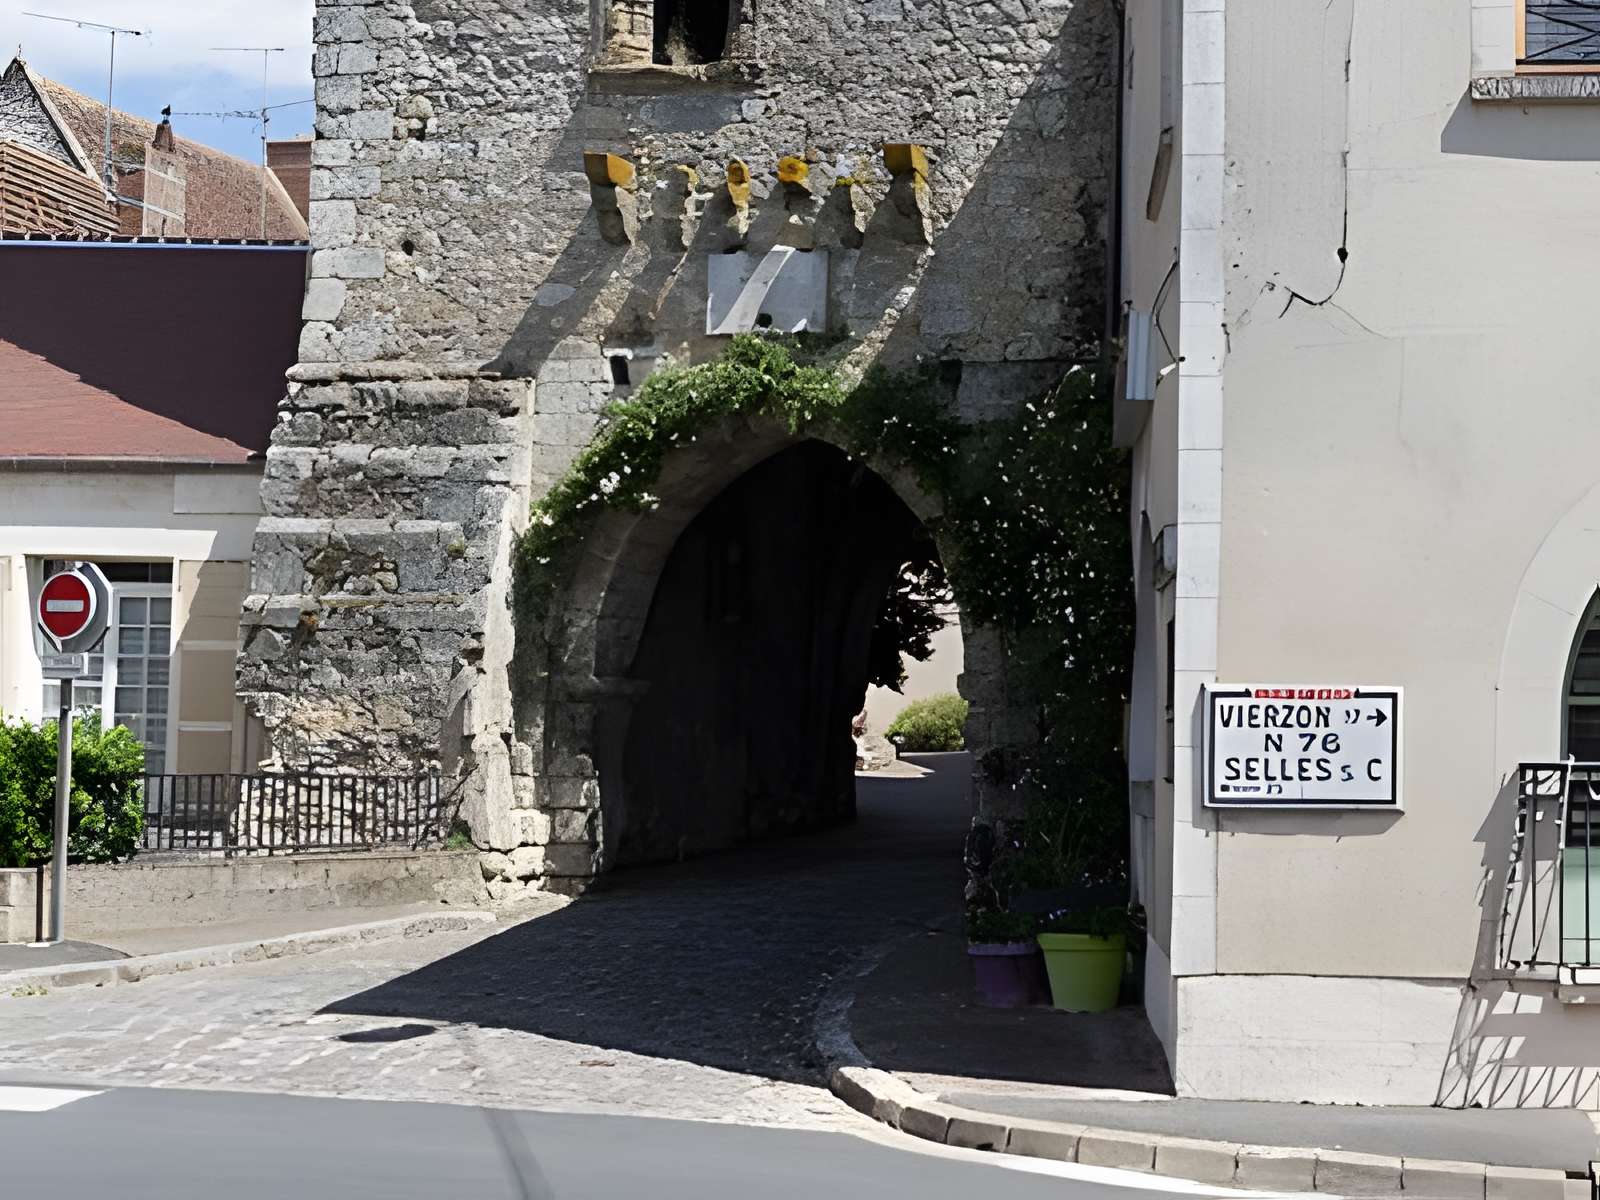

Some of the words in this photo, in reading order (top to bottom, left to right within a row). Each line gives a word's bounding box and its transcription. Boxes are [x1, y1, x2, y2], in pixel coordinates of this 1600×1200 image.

[1219, 704, 1331, 729] VIERZON
[1264, 733, 1283, 753] N
[1224, 757, 1332, 781] SELLES
[1366, 757, 1383, 781] C
